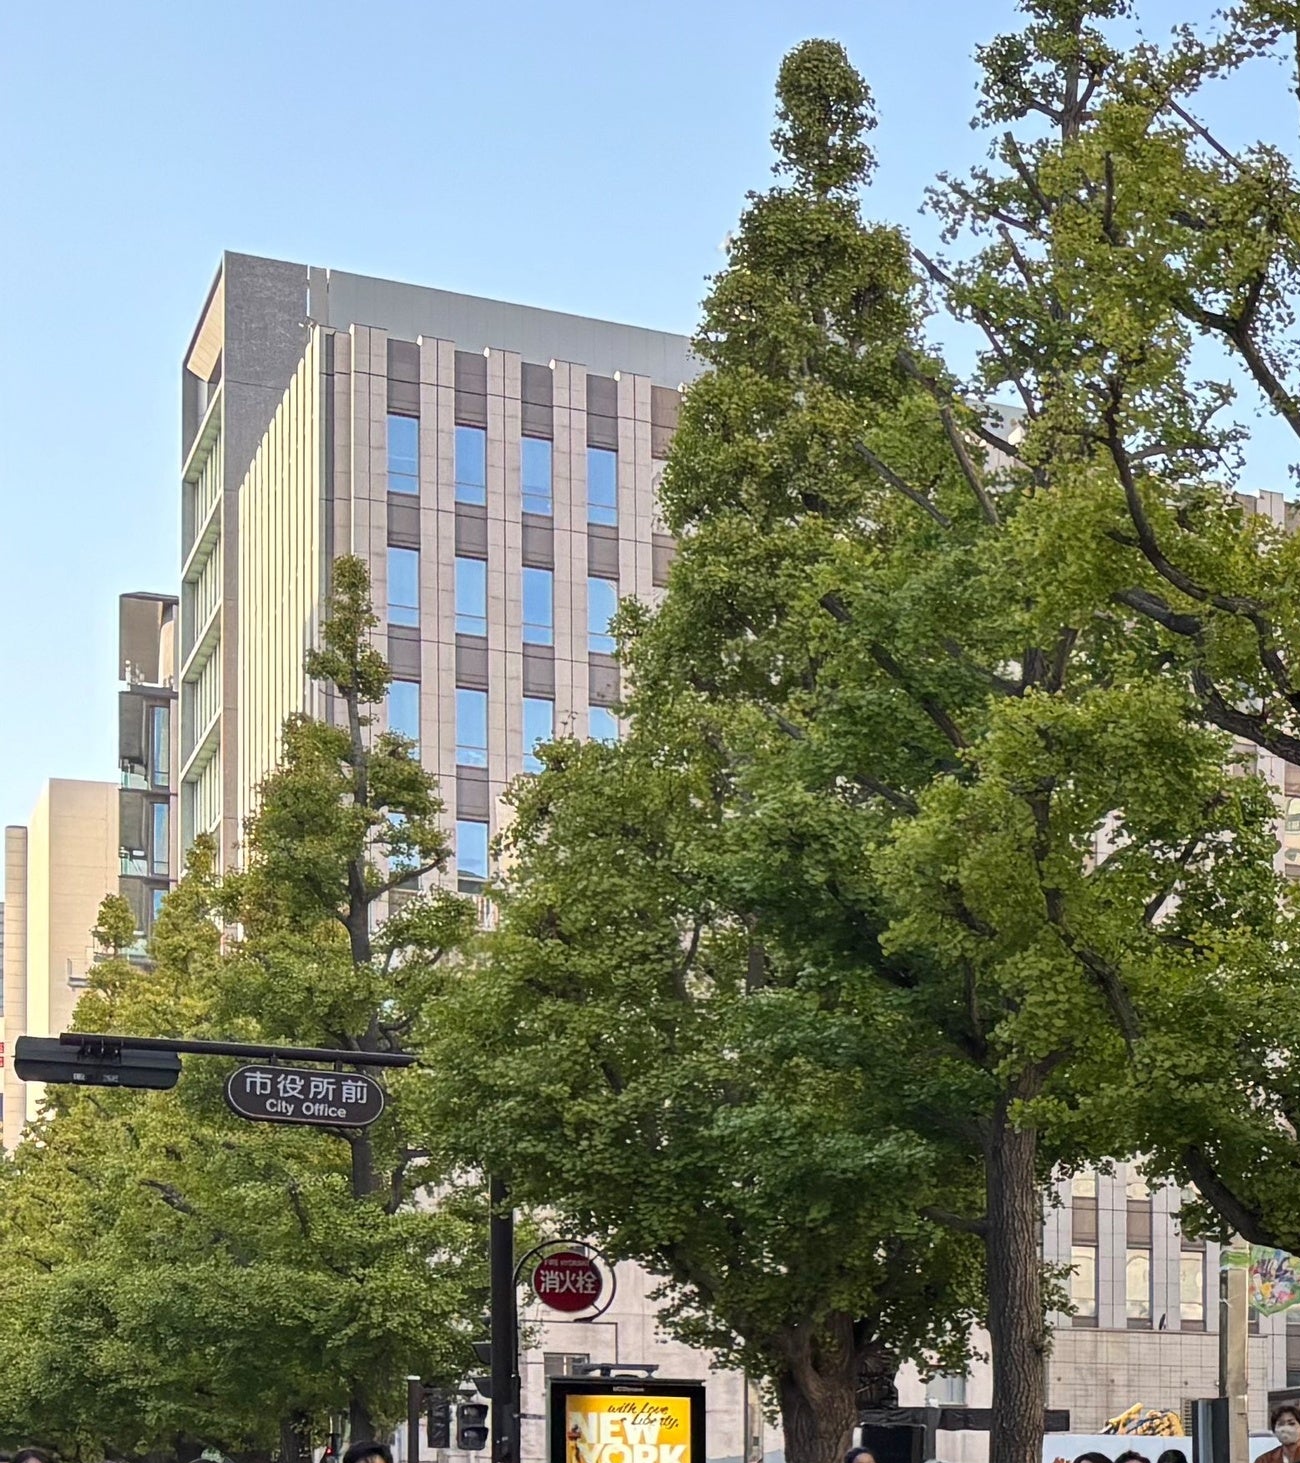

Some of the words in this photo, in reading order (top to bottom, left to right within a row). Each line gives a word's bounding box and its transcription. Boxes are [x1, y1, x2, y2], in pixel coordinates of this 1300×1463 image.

[244, 1071, 368, 1104] 市役所前
[265, 1099, 295, 1116] City
[302, 1102, 347, 1118] Office
[540, 1269, 598, 1294] 消火栓
[571, 1412, 662, 1445] NEW
